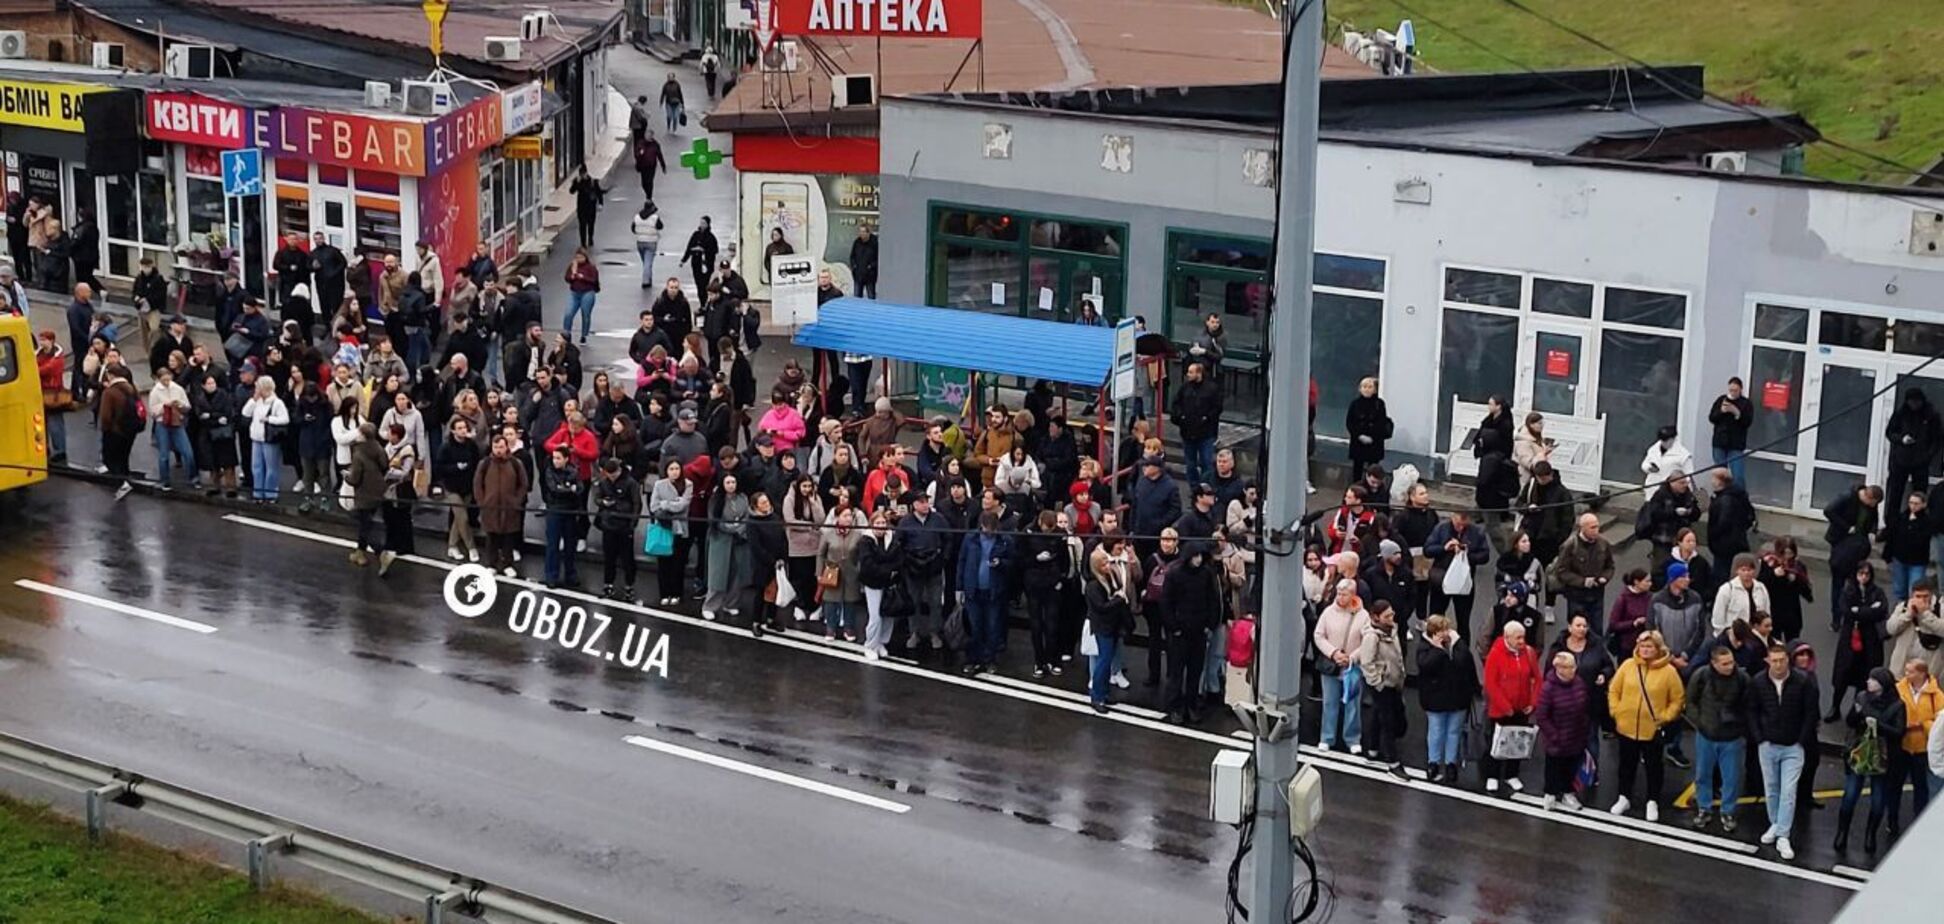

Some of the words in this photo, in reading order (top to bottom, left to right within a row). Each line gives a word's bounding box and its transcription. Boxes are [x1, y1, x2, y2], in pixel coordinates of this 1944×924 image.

[808, 0, 948, 32] АПТЕКА
[153, 99, 240, 139] КВІТИ
[254, 109, 414, 167] ELFBAR
[434, 102, 497, 166] ELFBAR
